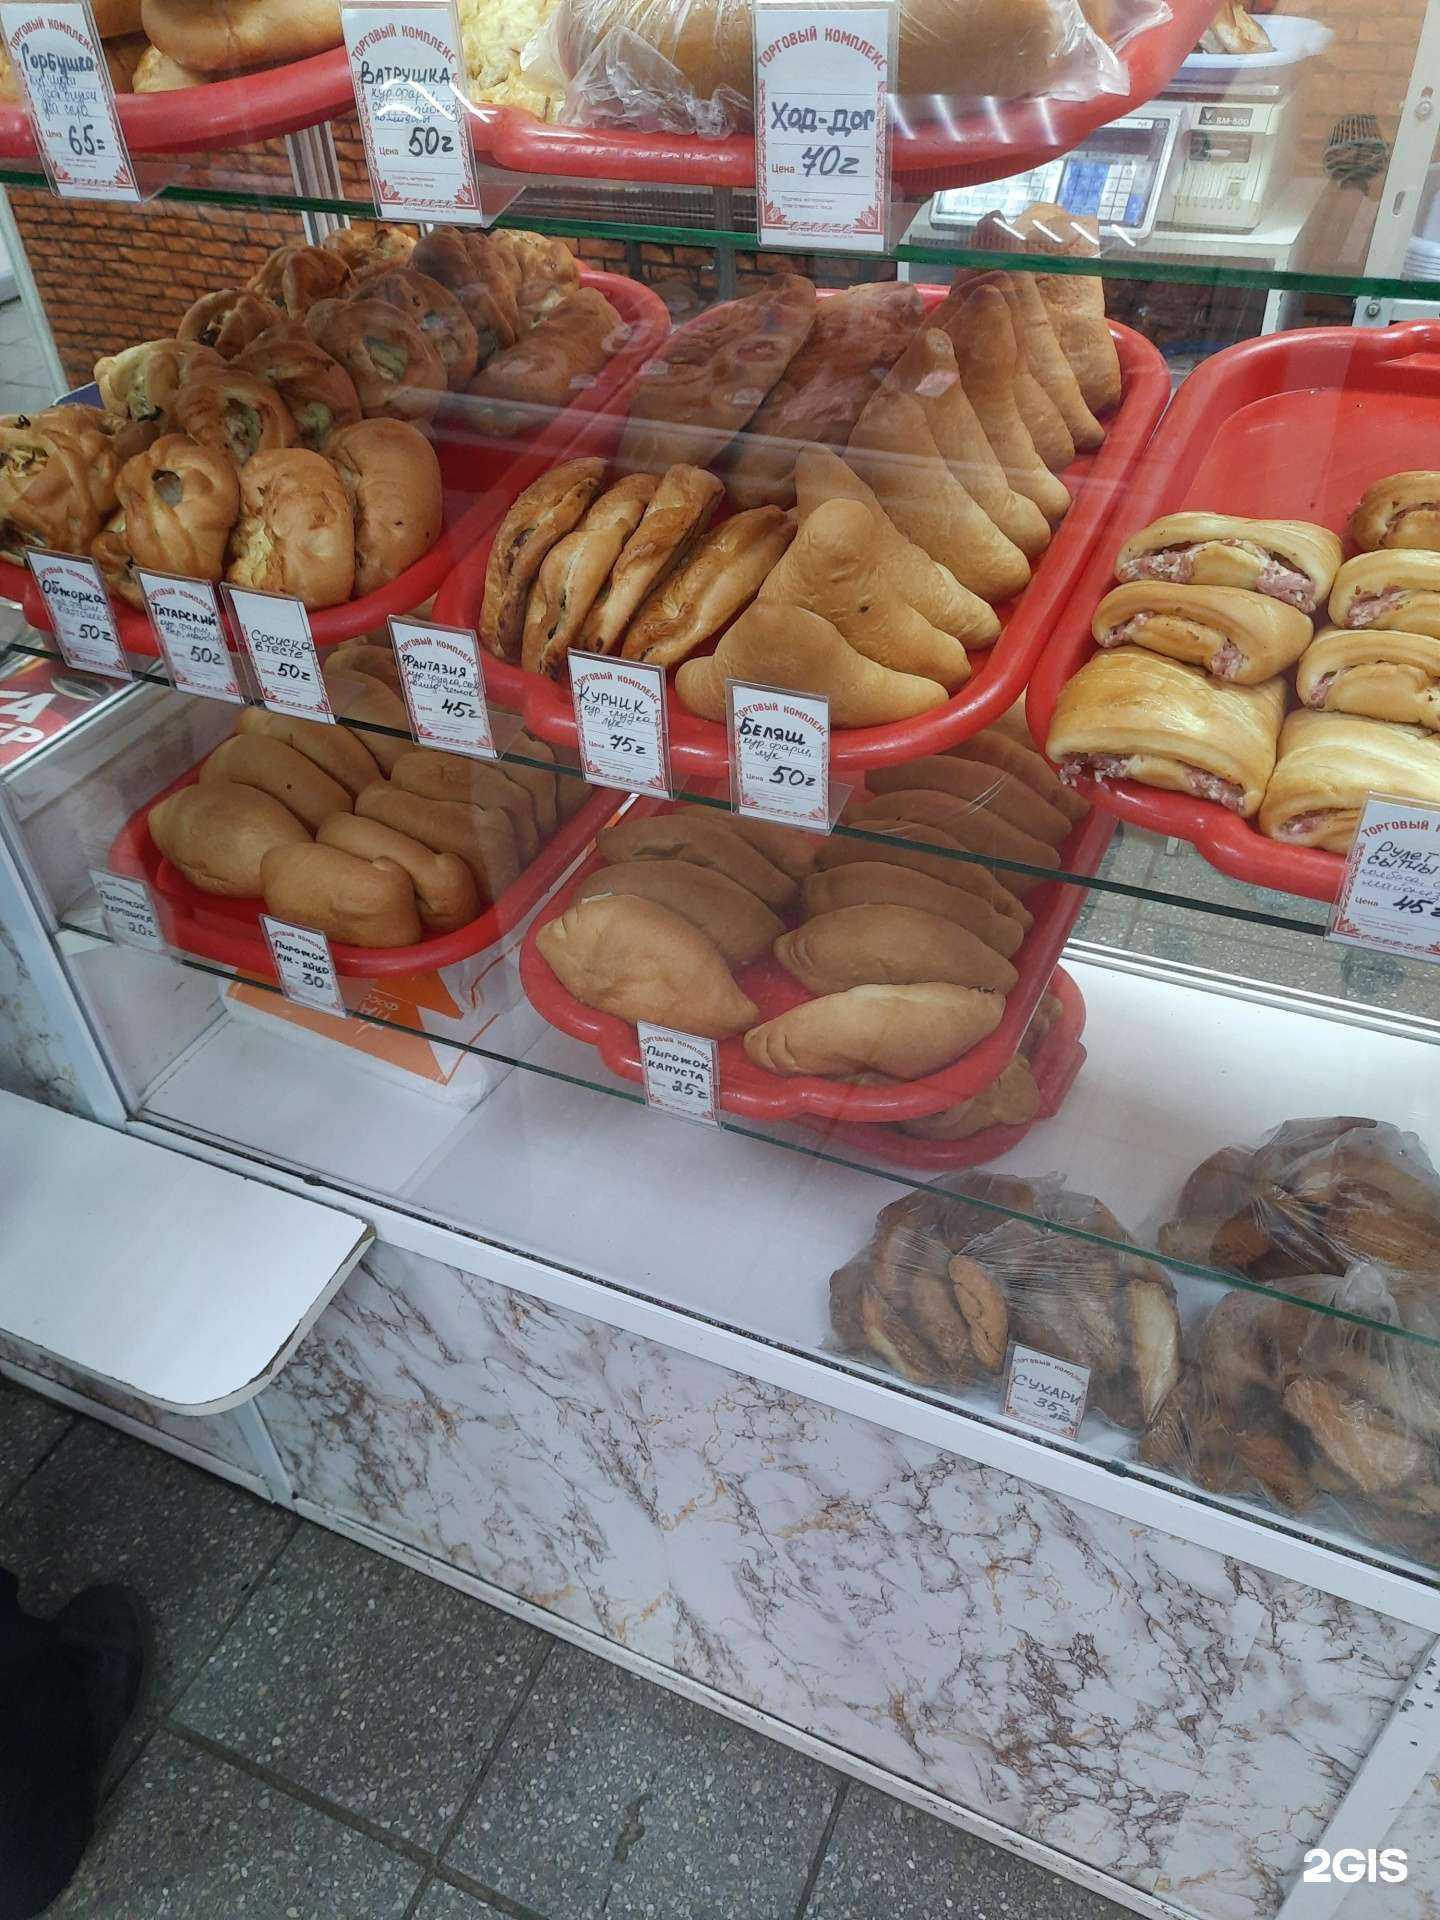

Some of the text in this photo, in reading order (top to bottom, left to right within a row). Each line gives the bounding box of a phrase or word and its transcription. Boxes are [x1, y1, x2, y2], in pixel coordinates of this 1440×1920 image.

[10, 16, 97, 54] ТОРГОВЫЙ КОМПЛЕКС
[351, 23, 456, 64] ТОРГОВЫЙ КОМПЛЕКС
[758, 25, 888, 71] ТОРГОВЫЙ КОМПЛЕКС
[21, 42, 97, 77] Горбушка
[361, 60, 451, 85] ВАТРУШКА
[379, 146, 399, 156] Цена
[771, 163, 795, 174] Цена
[398, 636, 477, 667] ТОРГОВЫЙ КОМПЛЕКС
[573, 671, 661, 704] ТОРГОВЫЙ КОМПЛЕКС
[735, 702, 829, 737] ТОРГОВЫЙ КОМПЛЕКС
[1362, 820, 1429, 838] ТОРГОВЫЙ
[1374, 841, 1440, 863] Рулет
[1355, 896, 1379, 907] Цена
[1013, 1374, 1081, 1406] СУХАРИ
